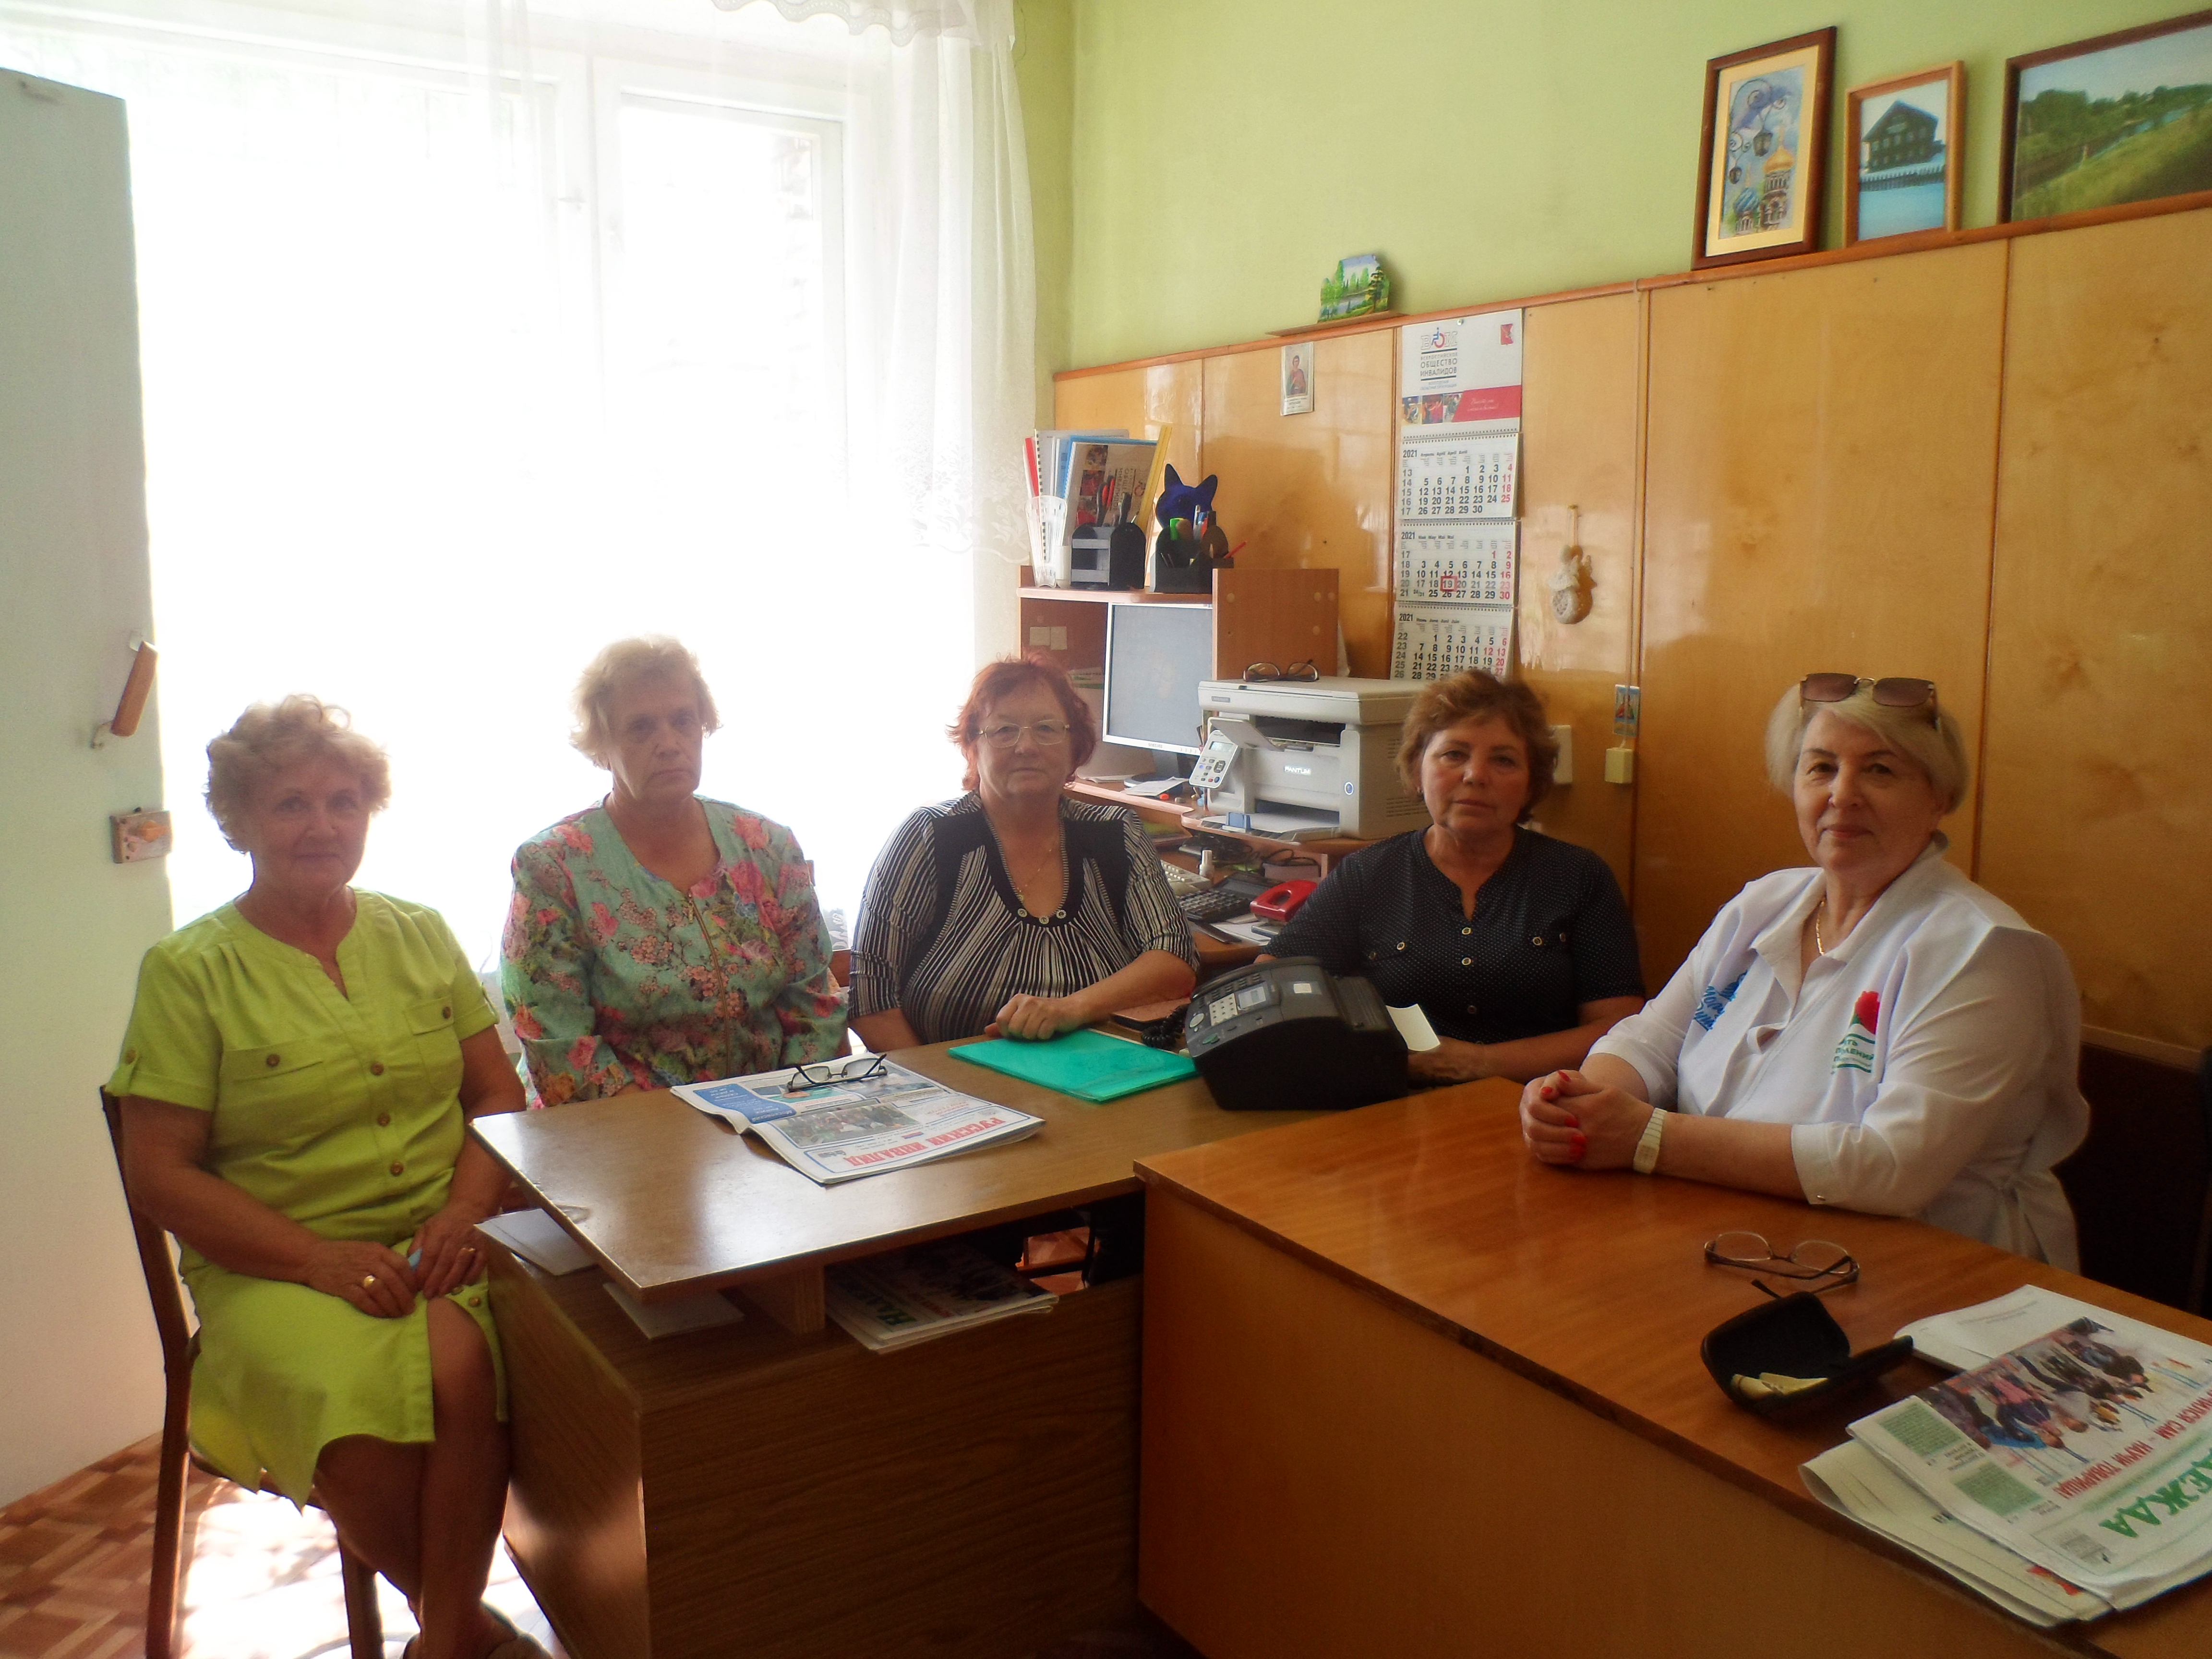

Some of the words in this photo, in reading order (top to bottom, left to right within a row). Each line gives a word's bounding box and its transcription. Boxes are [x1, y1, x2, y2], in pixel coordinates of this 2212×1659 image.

[1420, 358, 1457, 368] ОБЩЕСТВО
[1420, 367, 1457, 376] ИНВАЛИДОВ
[1494, 464, 1499, 472] 3
[1501, 494, 1510, 503] 25
[1473, 505, 1482, 513] 30
[1484, 647, 1493, 655] 12
[1284, 766, 1310, 775] PANTUM
[926, 1118, 1007, 1146] РУССКИЙ
[843, 1142, 928, 1166] ИНВАЛИД
[2153, 1420, 2186, 1440] САМ
[2111, 1440, 2154, 1467] НАУЧИ
